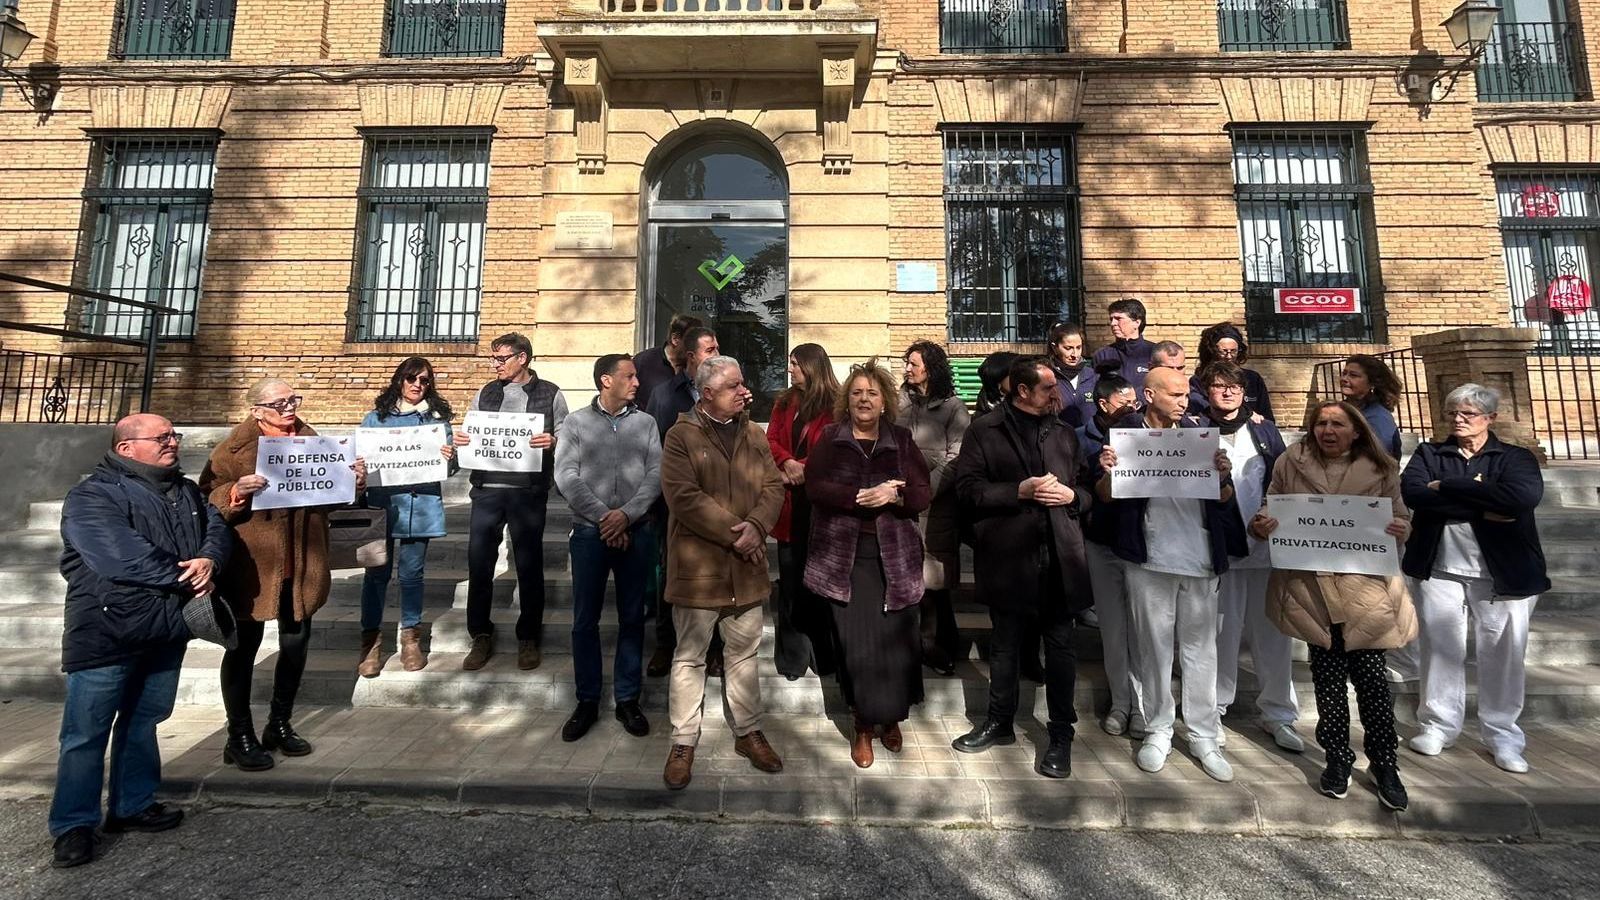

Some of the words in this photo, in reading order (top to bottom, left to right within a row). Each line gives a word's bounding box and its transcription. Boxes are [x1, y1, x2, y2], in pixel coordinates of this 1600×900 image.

[1284, 295, 1347, 305] CCOO
[467, 426, 480, 434] EN
[484, 427, 533, 437] DEFENSA
[379, 445, 393, 453] NO
[404, 444, 422, 452] LAS
[481, 438, 496, 447] DE
[502, 439, 517, 448] LO
[474, 447, 523, 459] PÚBLICO
[1137, 449, 1153, 458] NO
[1155, 449, 1164, 457] A
[1166, 449, 1187, 458] LAS
[268, 455, 284, 465] EN
[288, 453, 346, 464] DEFENSA
[364, 458, 442, 470] RIVATIZACIONES
[285, 468, 302, 478] DE
[310, 467, 327, 477] LO
[1114, 469, 1212, 478] PRIVATIZACIONES
[277, 479, 334, 493] PÚBLICO
[1297, 516, 1316, 526] NO
[1319, 518, 1329, 527] A
[1331, 518, 1355, 528] LAS
[1271, 537, 1388, 554] PRIVATIZACIONES
